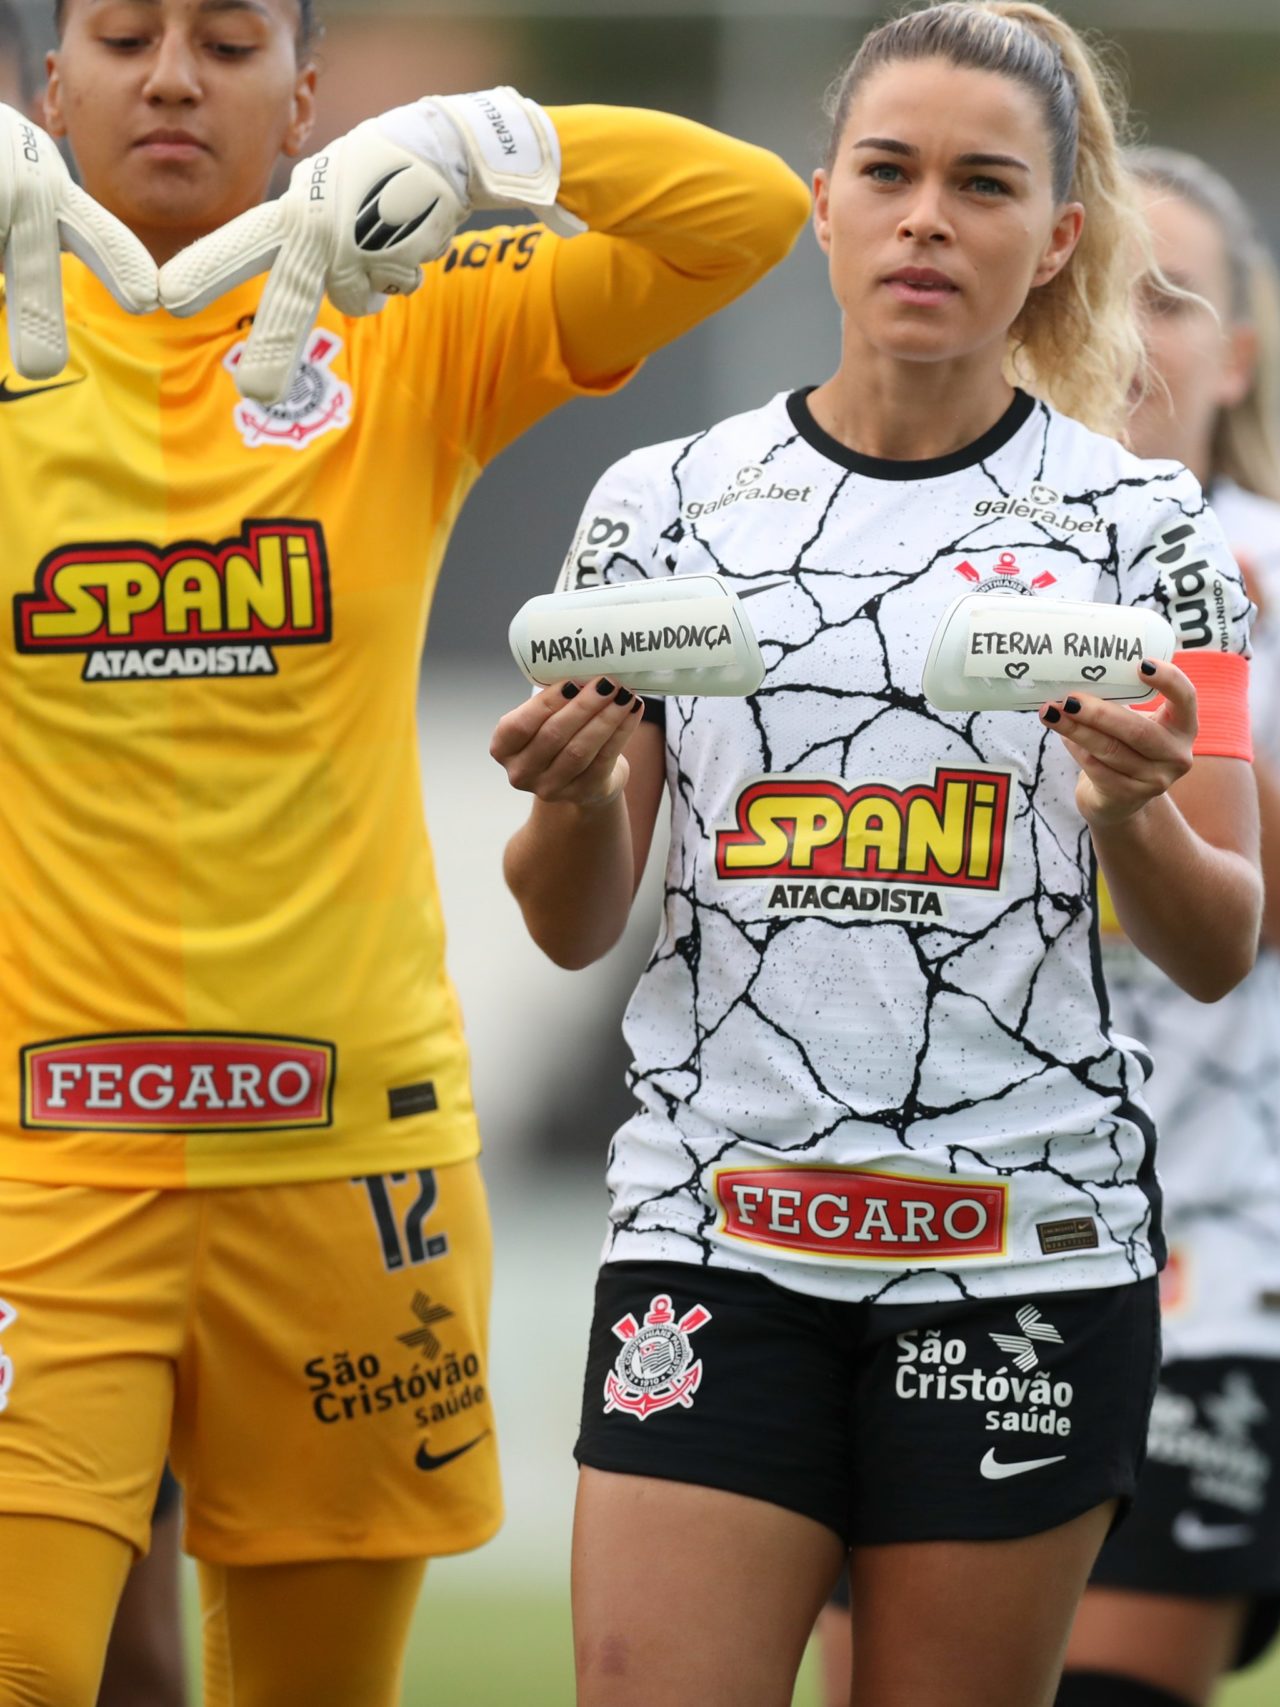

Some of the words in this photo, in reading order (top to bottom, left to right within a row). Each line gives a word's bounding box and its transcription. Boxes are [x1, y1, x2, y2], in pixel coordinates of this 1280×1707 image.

[19, 123, 39, 163] PRO
[310, 156, 329, 201] PRO
[685, 483, 811, 519] galera.bet
[974, 499, 1105, 534] galera.bet
[574, 516, 629, 590] mg
[31, 535, 315, 638] SPANI
[1168, 559, 1213, 649] bm
[1213, 579, 1229, 653] CORINTHIA
[86, 646, 274, 679] ATACADISTA
[530, 627, 614, 663] MARÍLIA
[620, 624, 732, 657] MENDONÇA
[970, 632, 1053, 656] ETERNA
[1063, 632, 1144, 662] RAINHA
[725, 781, 996, 878] SPANI
[768, 884, 943, 917] ATACADISTA
[46, 1061, 312, 1110] FEGARO
[349, 1167, 449, 1271] 12
[731, 1183, 988, 1243] FEGARO
[625, 1328, 672, 1366] CORINTHIANS
[667, 1334, 682, 1375] PAULISTA
[896, 1329, 966, 1365] São
[305, 1351, 380, 1392] São
[313, 1351, 480, 1423] Cristóvão
[640, 1378, 660, 1387] 1910
[895, 1365, 1073, 1408] Cristóvão
[414, 1384, 485, 1428] saúde
[985, 1406, 1071, 1436] saúde
